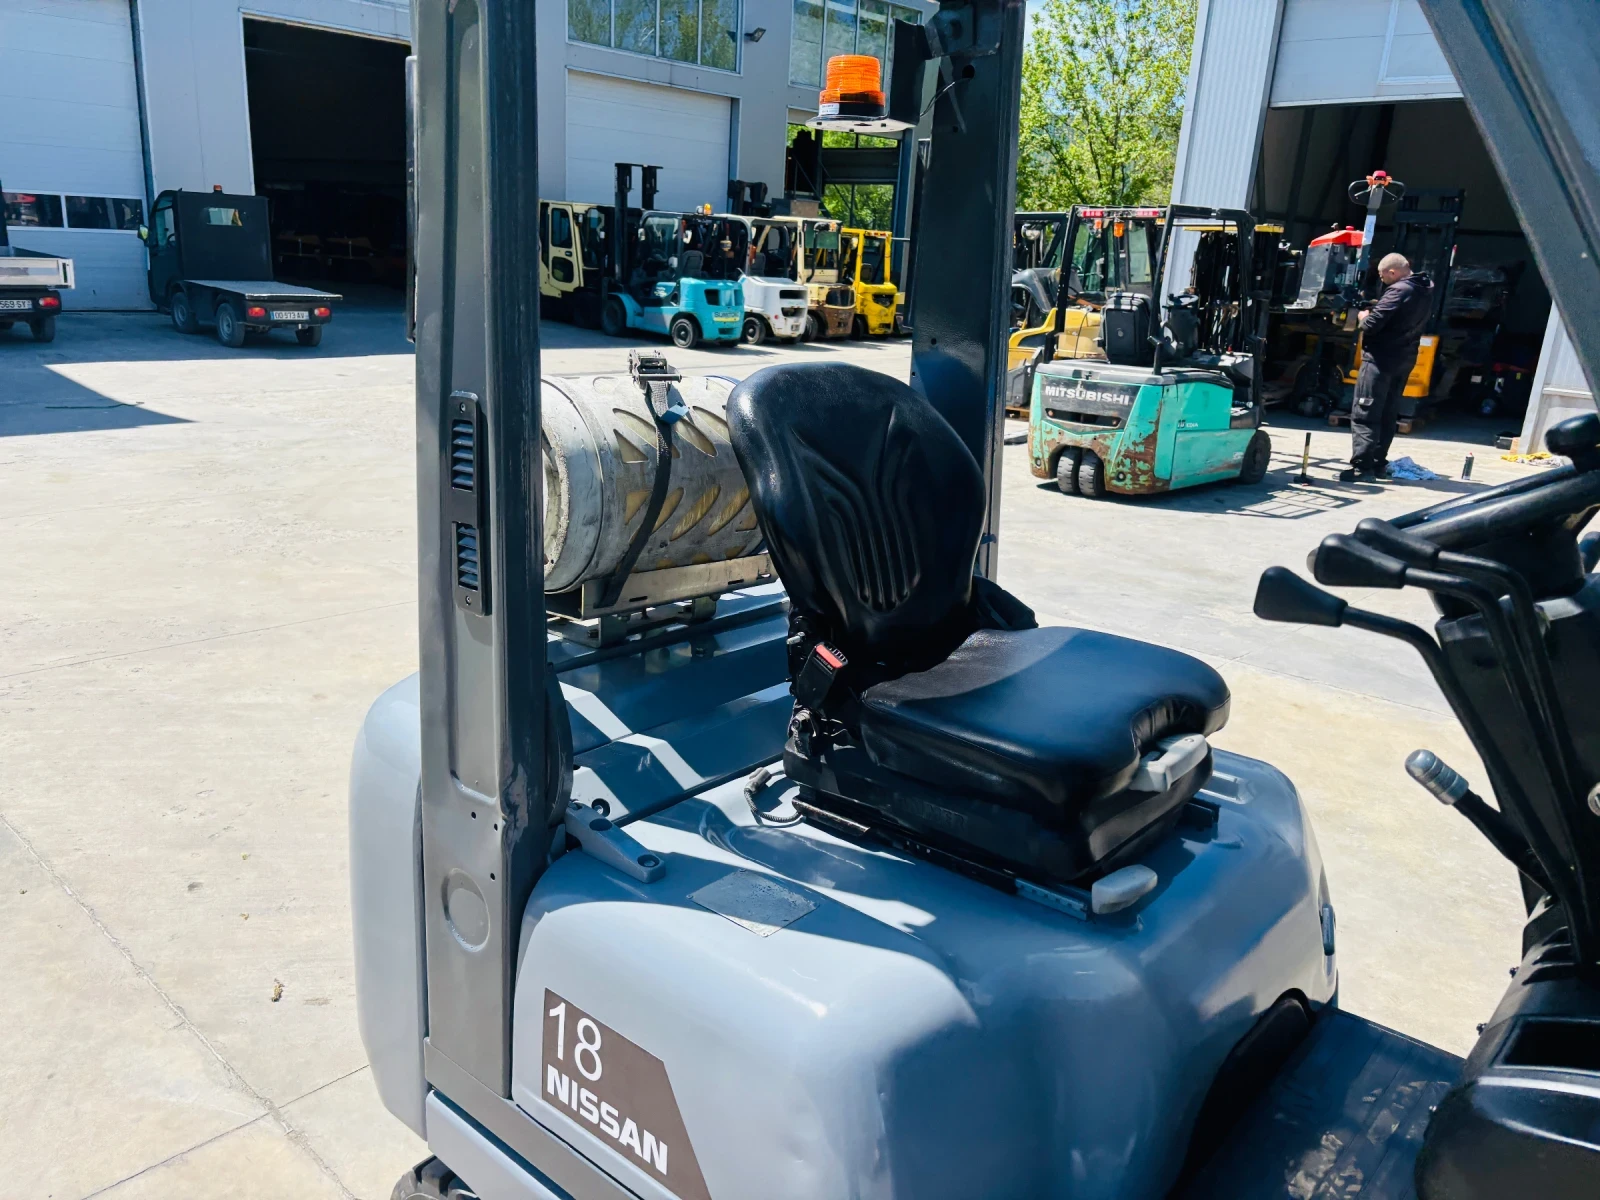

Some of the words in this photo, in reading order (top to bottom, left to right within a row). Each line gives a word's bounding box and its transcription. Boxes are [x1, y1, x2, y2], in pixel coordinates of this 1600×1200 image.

[1045, 385, 1130, 405] MITSUBISHI
[549, 1001, 603, 1082] 18
[547, 1063, 668, 1176] NISSAN
